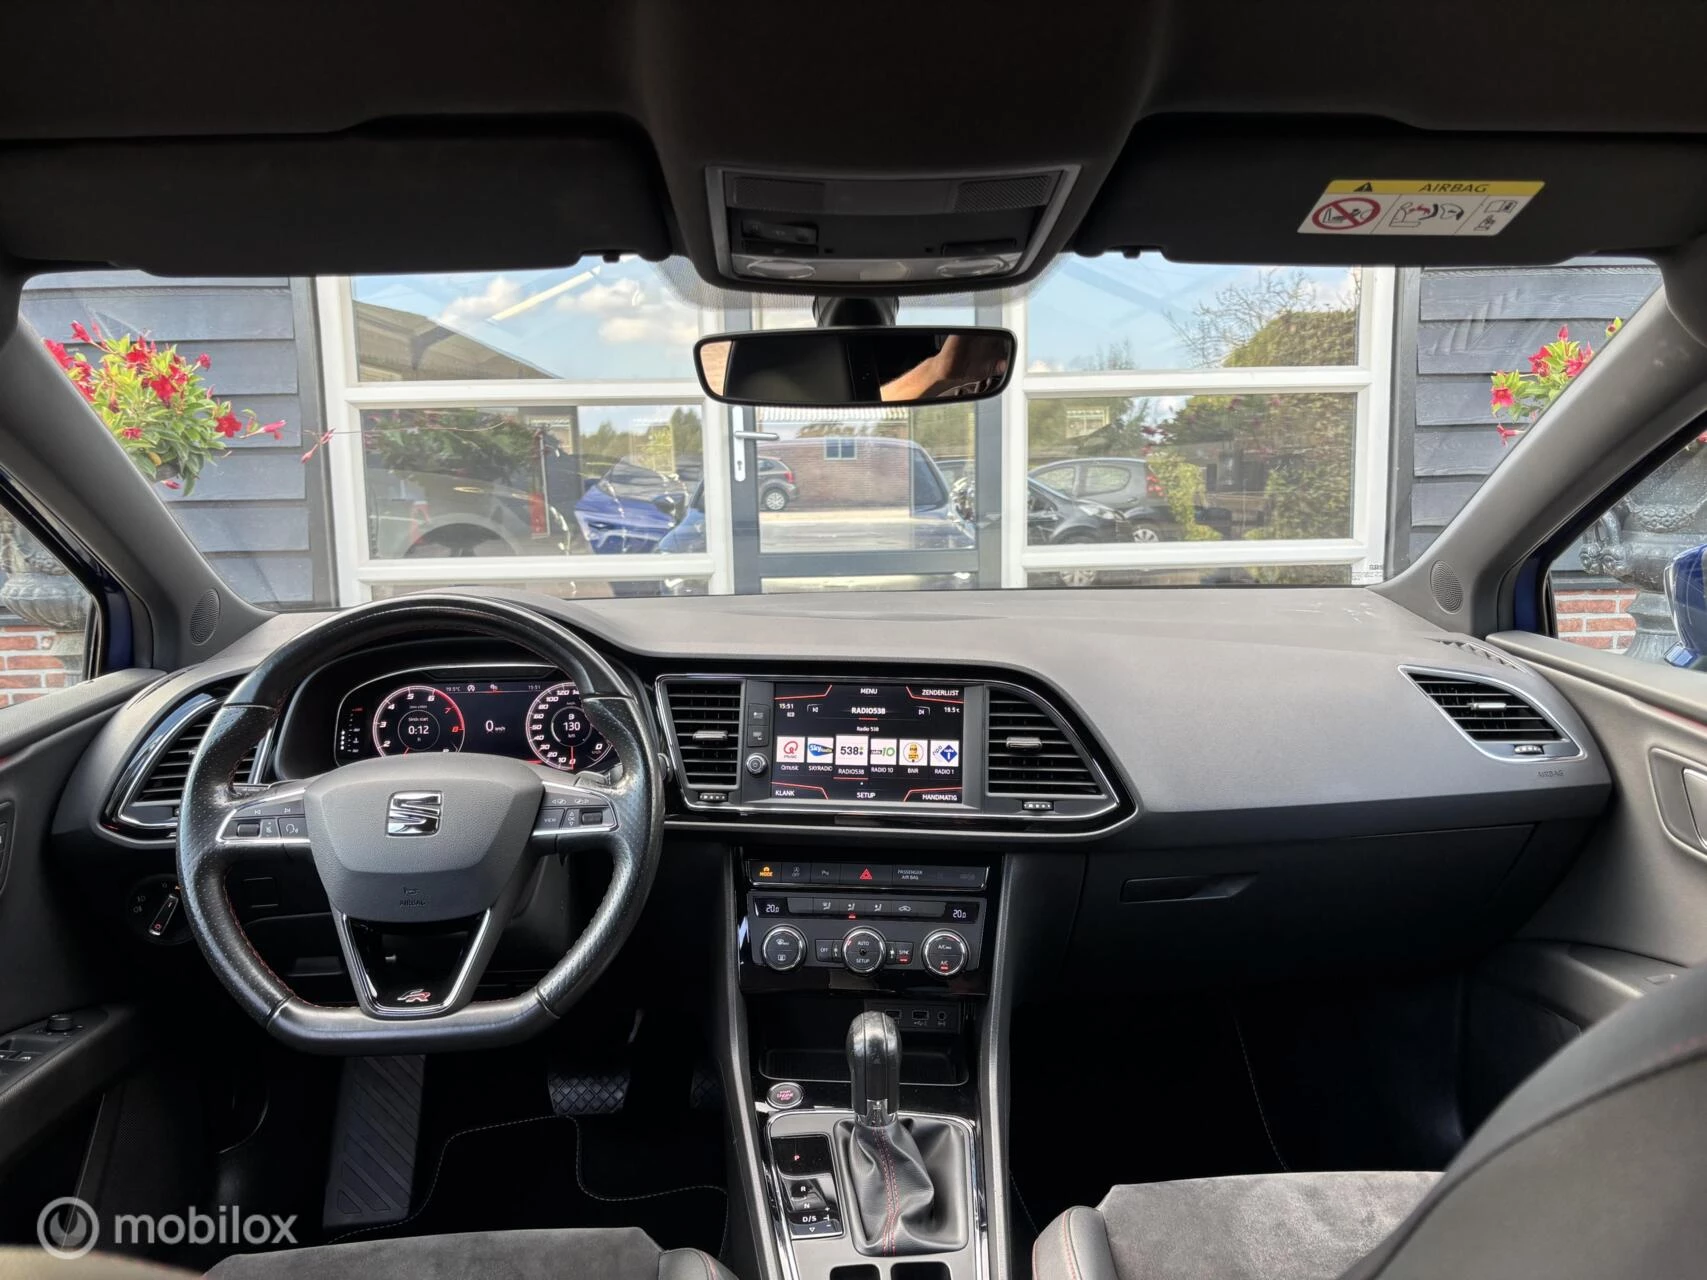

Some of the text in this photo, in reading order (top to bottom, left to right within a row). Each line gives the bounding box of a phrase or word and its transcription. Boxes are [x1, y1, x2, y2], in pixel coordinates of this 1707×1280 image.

[1418, 183, 1490, 193] AIRBAG
[851, 707, 886, 715] RADIO538
[408, 725, 429, 735] 0:12
[485, 720, 494, 732] 0
[563, 721, 581, 731] 130
[809, 744, 822, 753] Sky
[840, 746, 859, 756] 538
[882, 747, 896, 757] 10
[775, 789, 795, 797] KLANK
[802, 1215, 817, 1223] D/S
